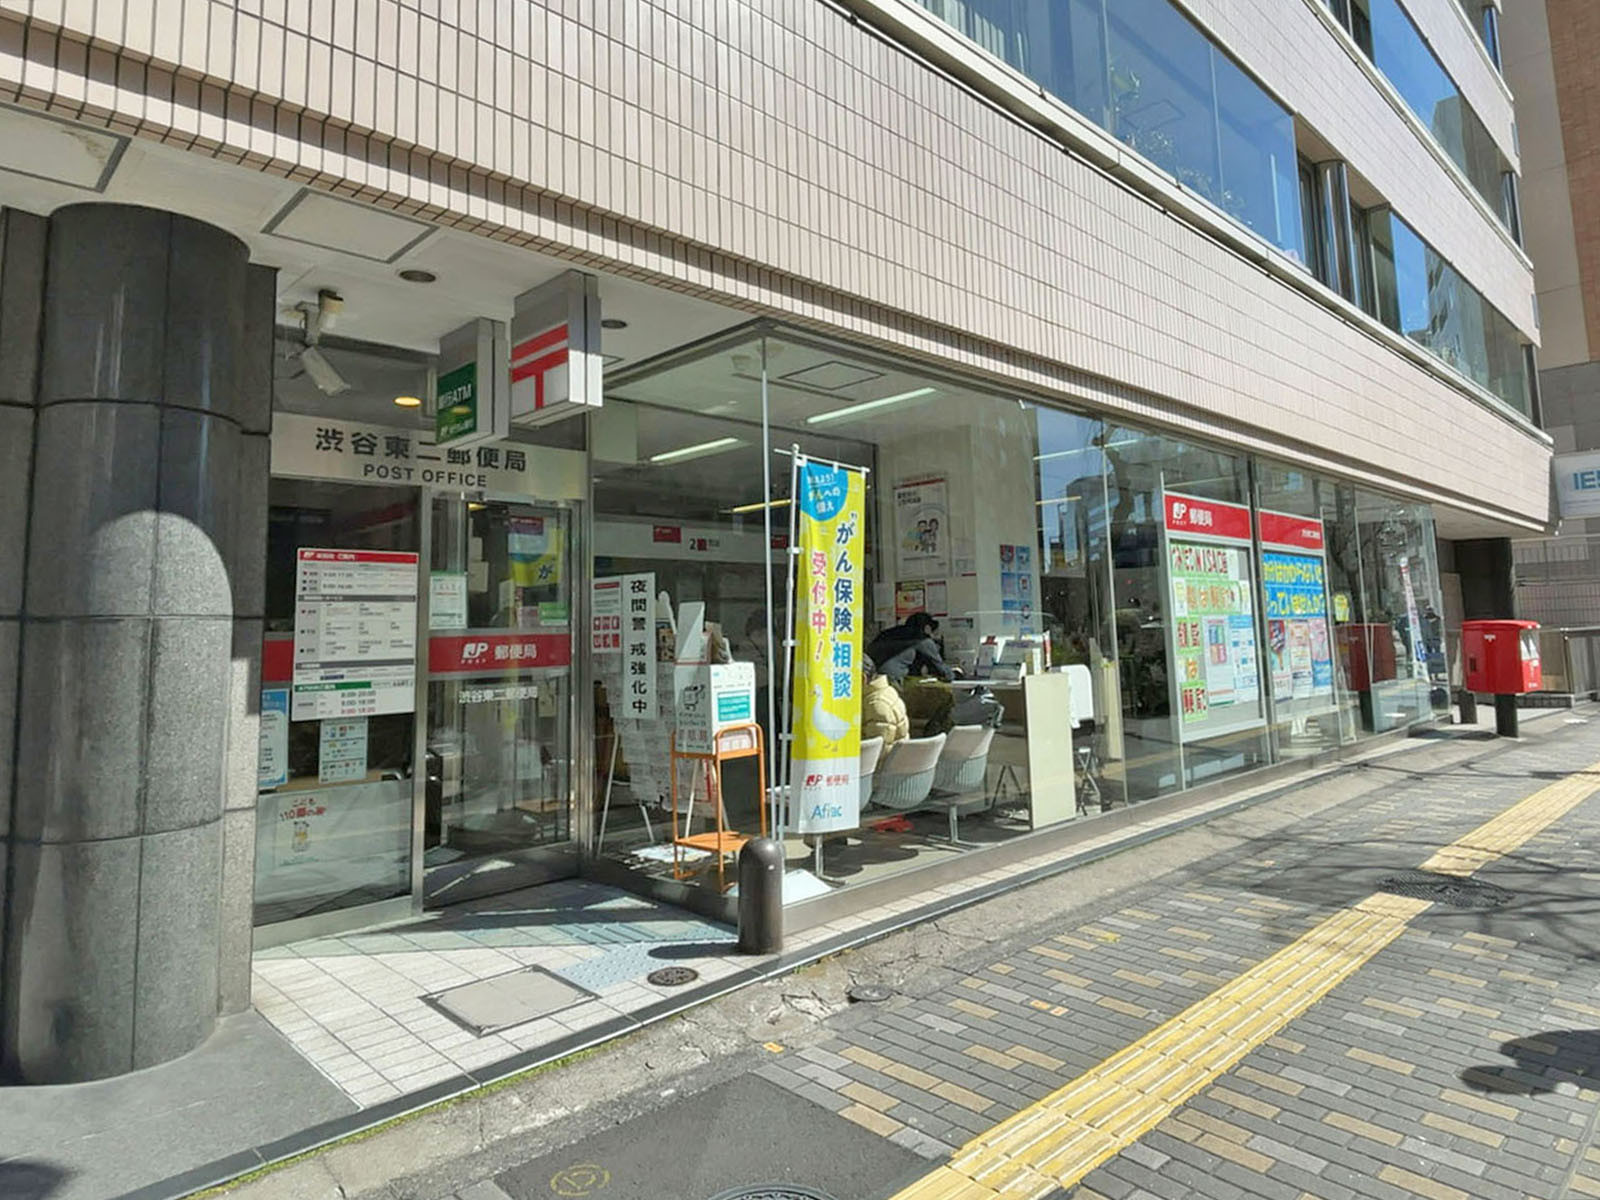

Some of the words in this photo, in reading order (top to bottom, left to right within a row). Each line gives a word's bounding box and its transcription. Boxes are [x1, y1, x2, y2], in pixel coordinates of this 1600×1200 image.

[315, 427, 526, 472] 渋谷東二郵便局
[363, 463, 414, 480] POST
[421, 468, 487, 487] OFFICE
[811, 803, 842, 820] Aflac
